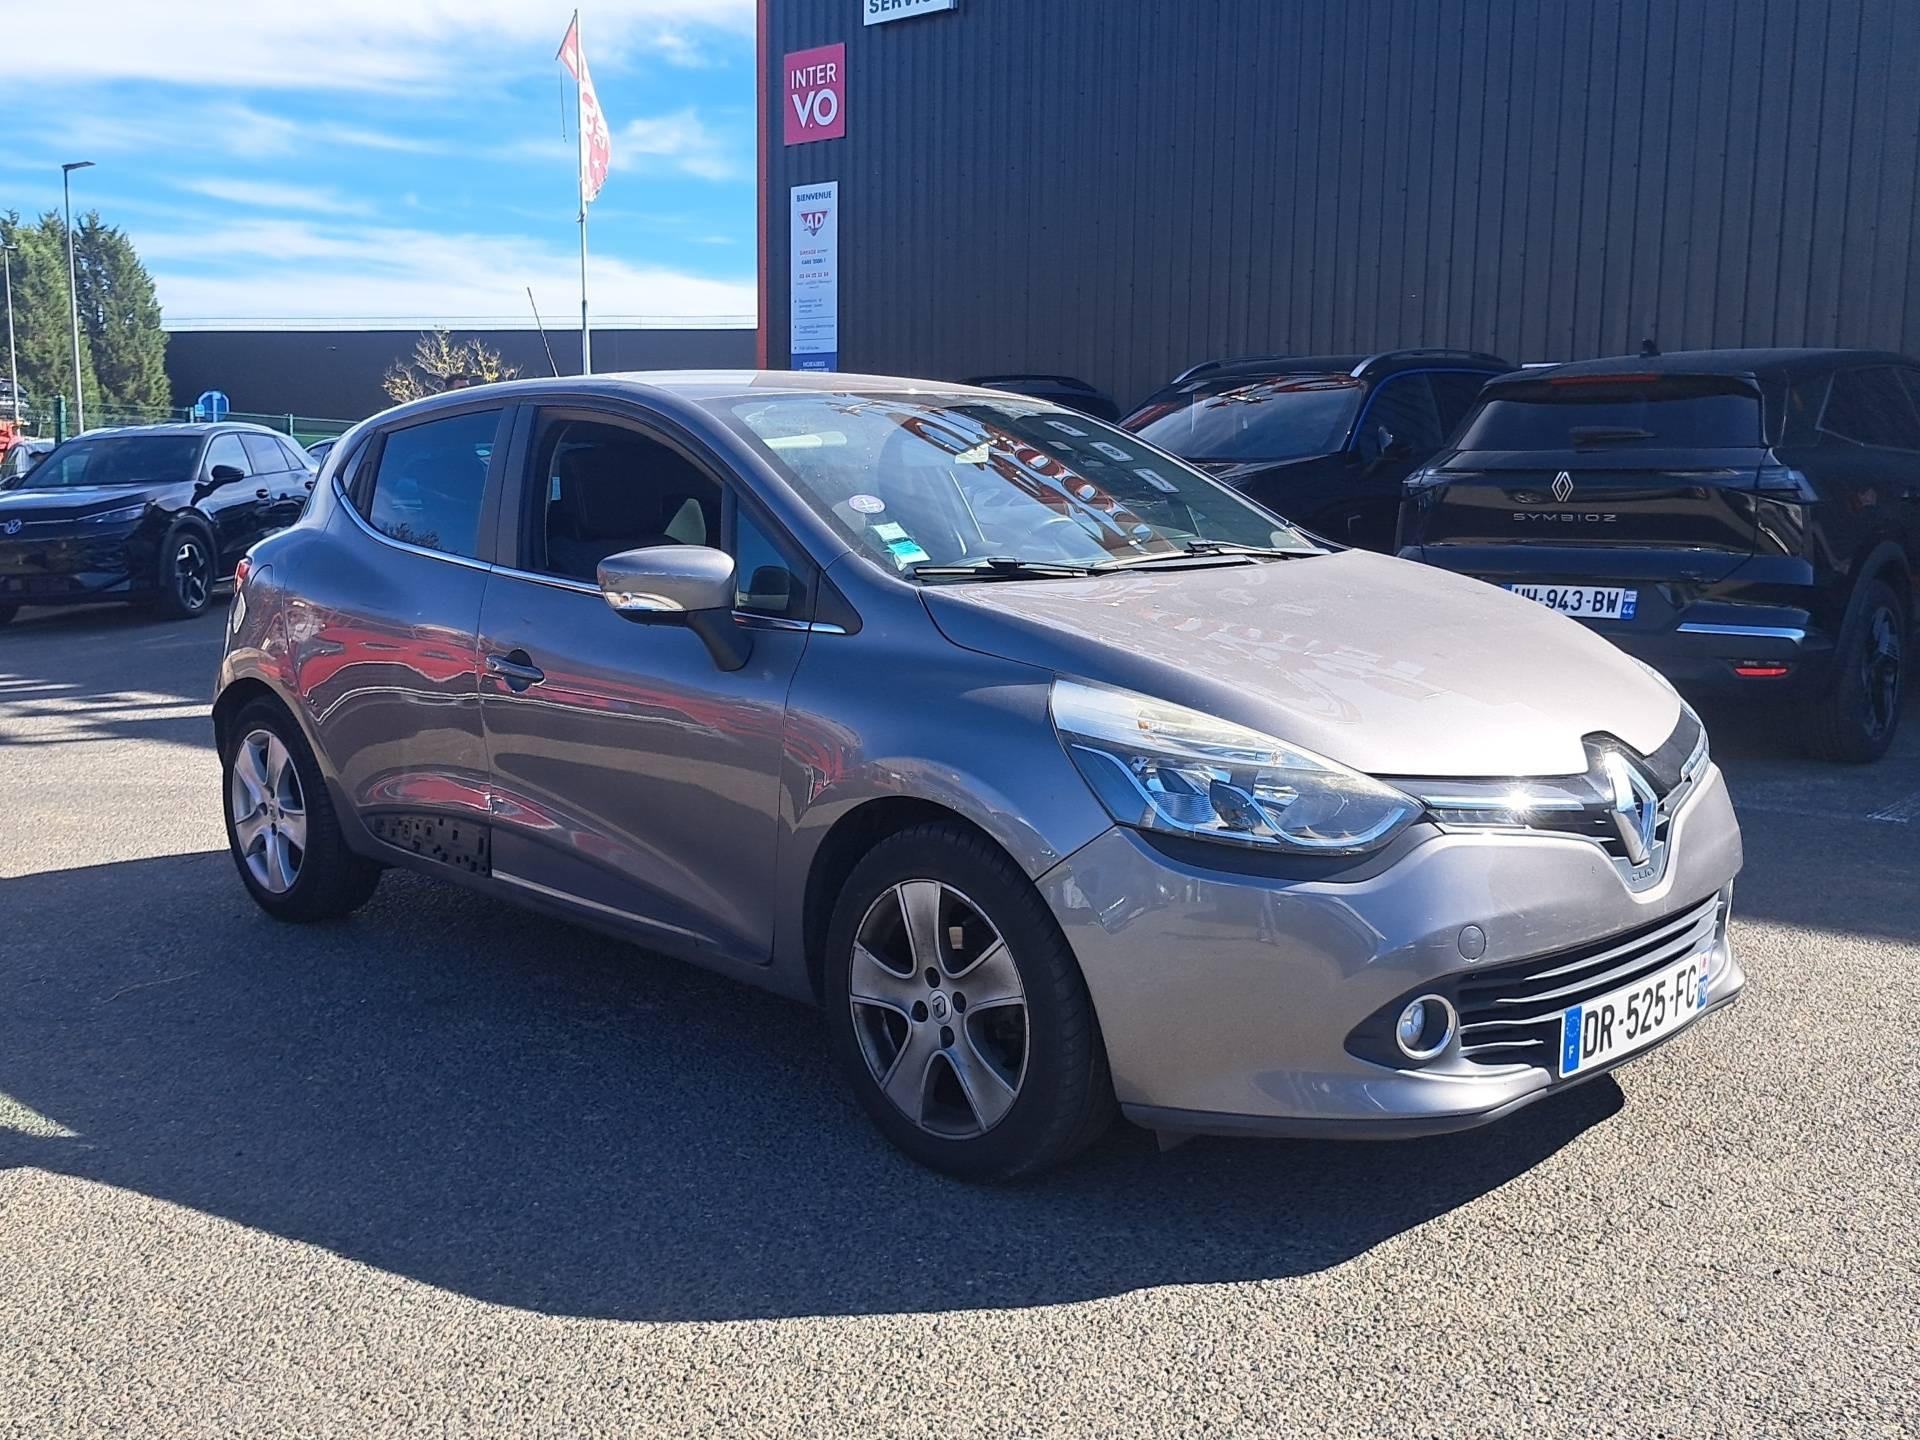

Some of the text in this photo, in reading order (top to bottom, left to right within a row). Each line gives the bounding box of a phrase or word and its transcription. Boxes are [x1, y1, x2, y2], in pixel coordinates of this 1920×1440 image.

[791, 63, 837, 89] INTER
[796, 190, 832, 202] BIENVENUE
[806, 212, 824, 230] AD
[1513, 513, 1617, 523] SYMBIOZ
[1582, 964, 1698, 1060] DR-525-FC
[1568, 1044, 1575, 1059] F
